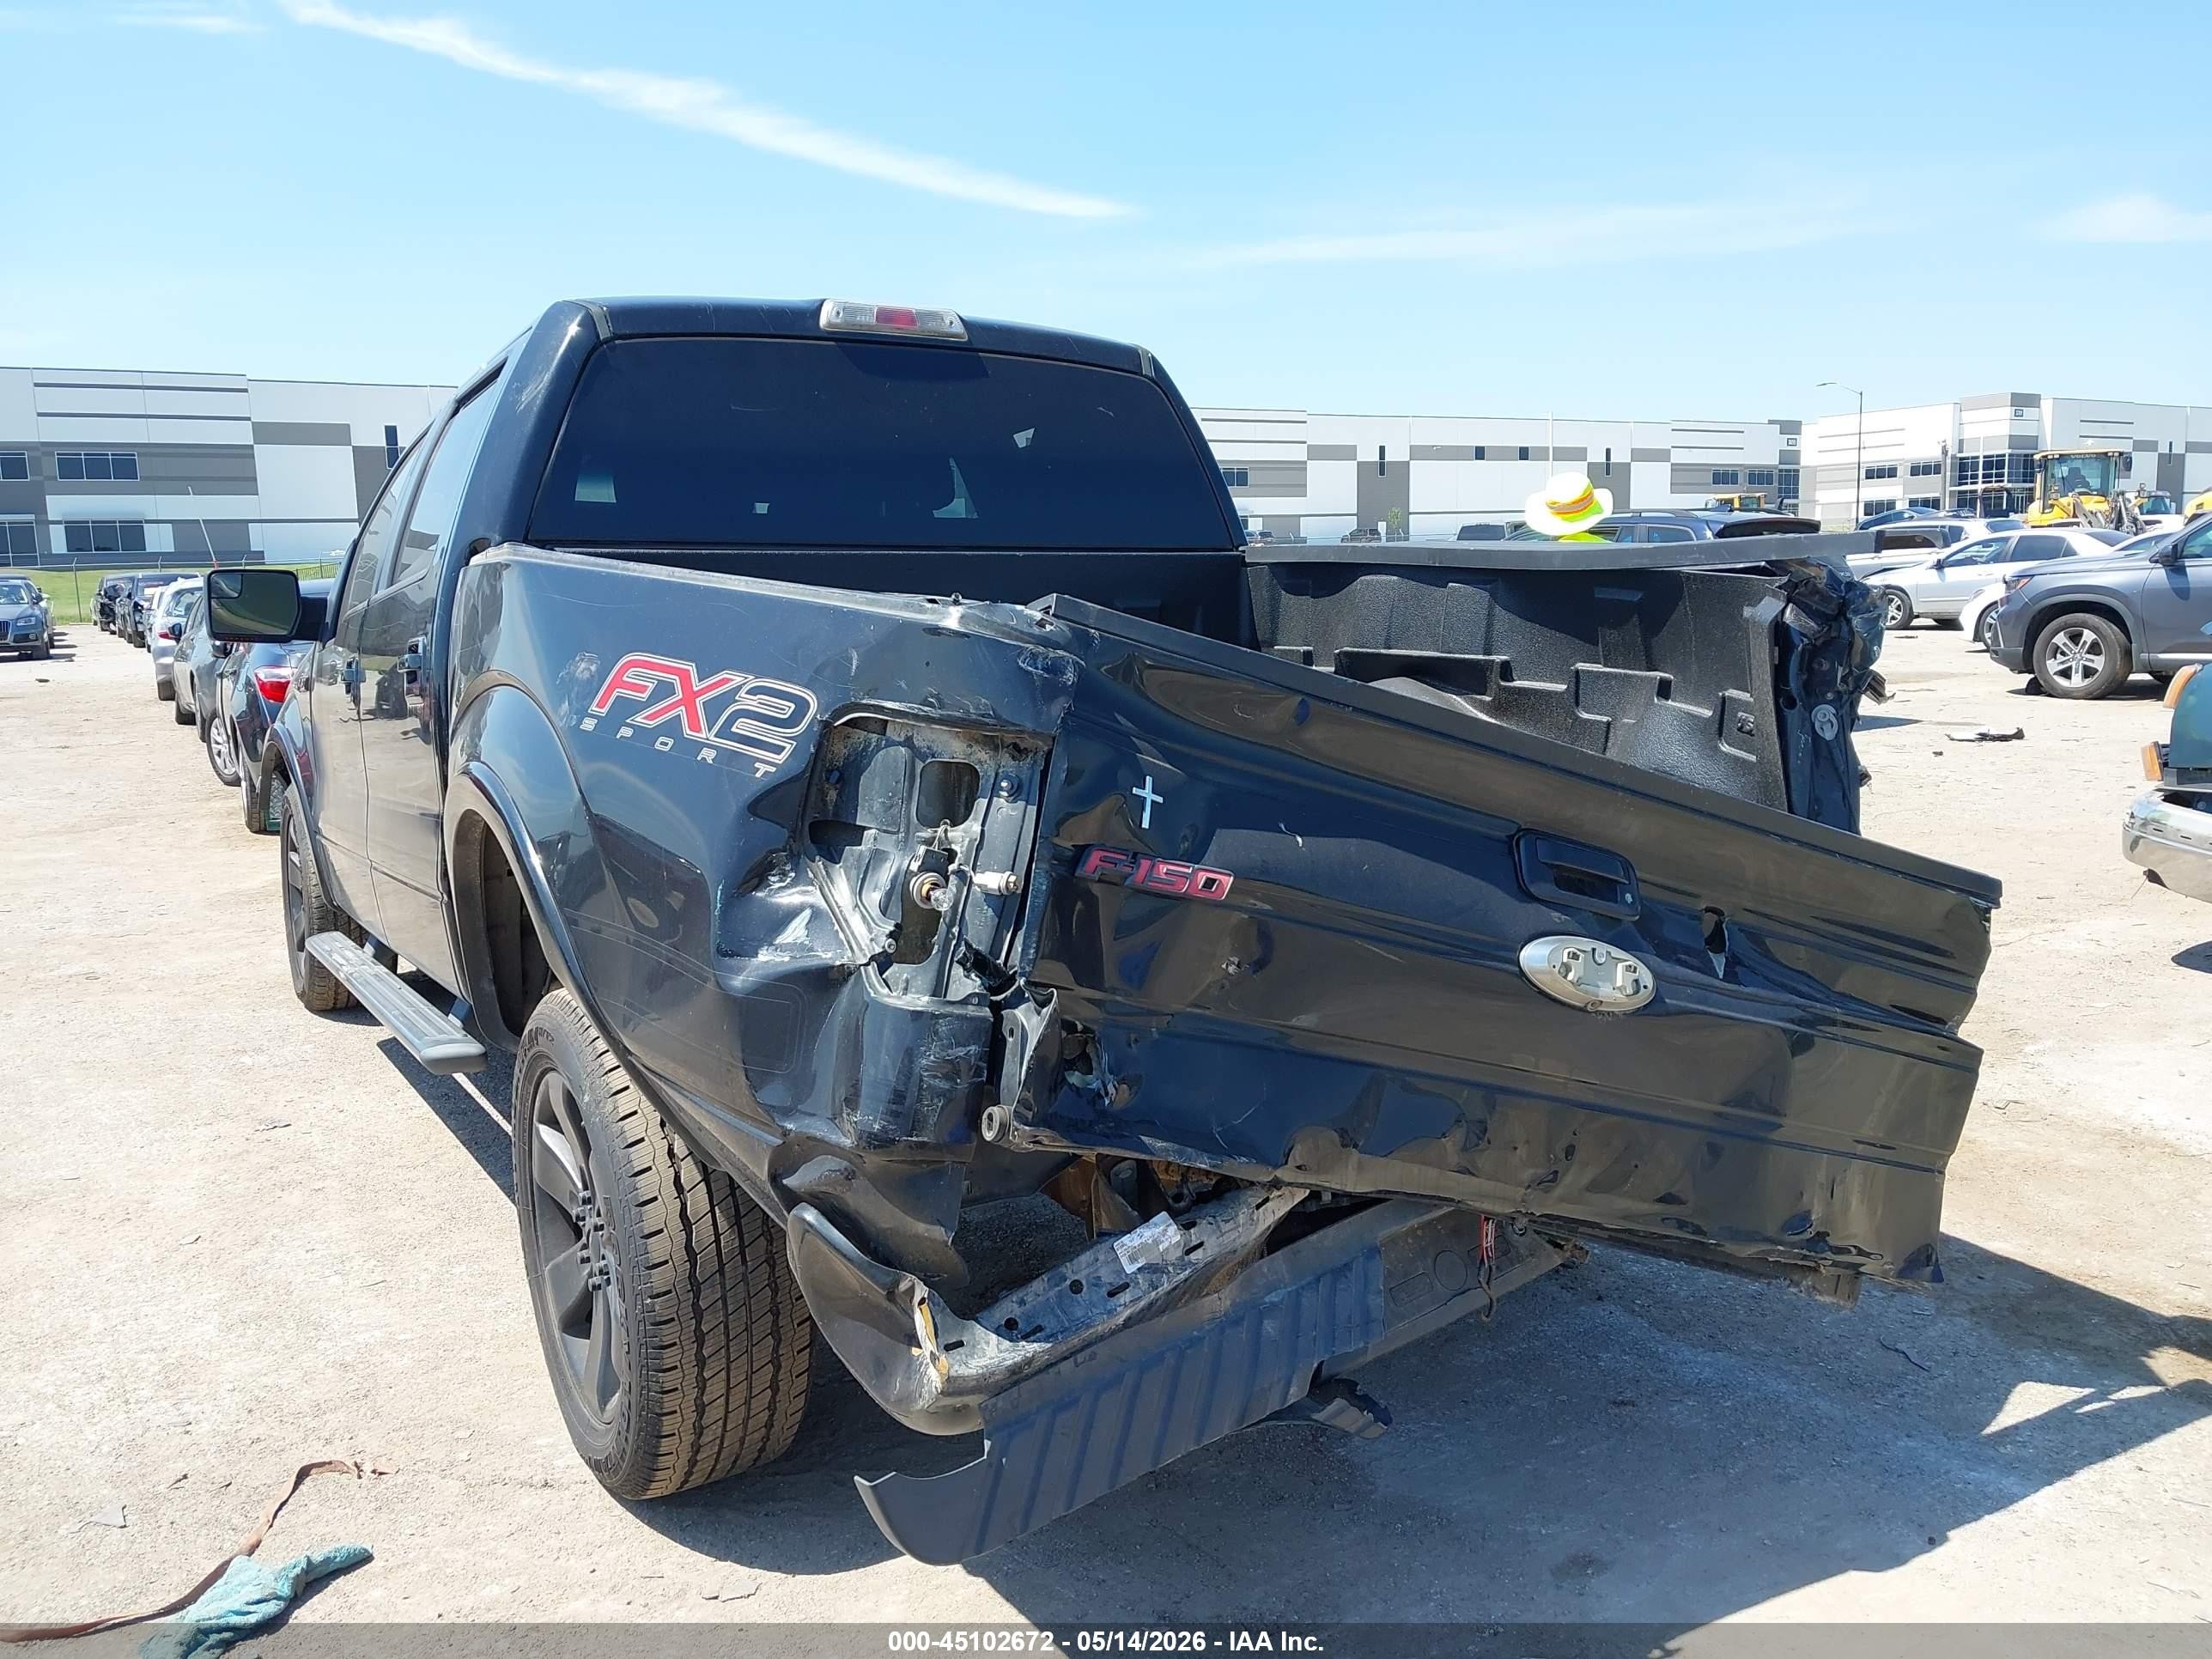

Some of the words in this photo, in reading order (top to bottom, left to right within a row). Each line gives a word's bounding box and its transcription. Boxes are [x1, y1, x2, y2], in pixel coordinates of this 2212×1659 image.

[587, 652, 817, 764] FX2
[579, 716, 777, 778] SPORT
[1077, 845, 1237, 901] F-150
